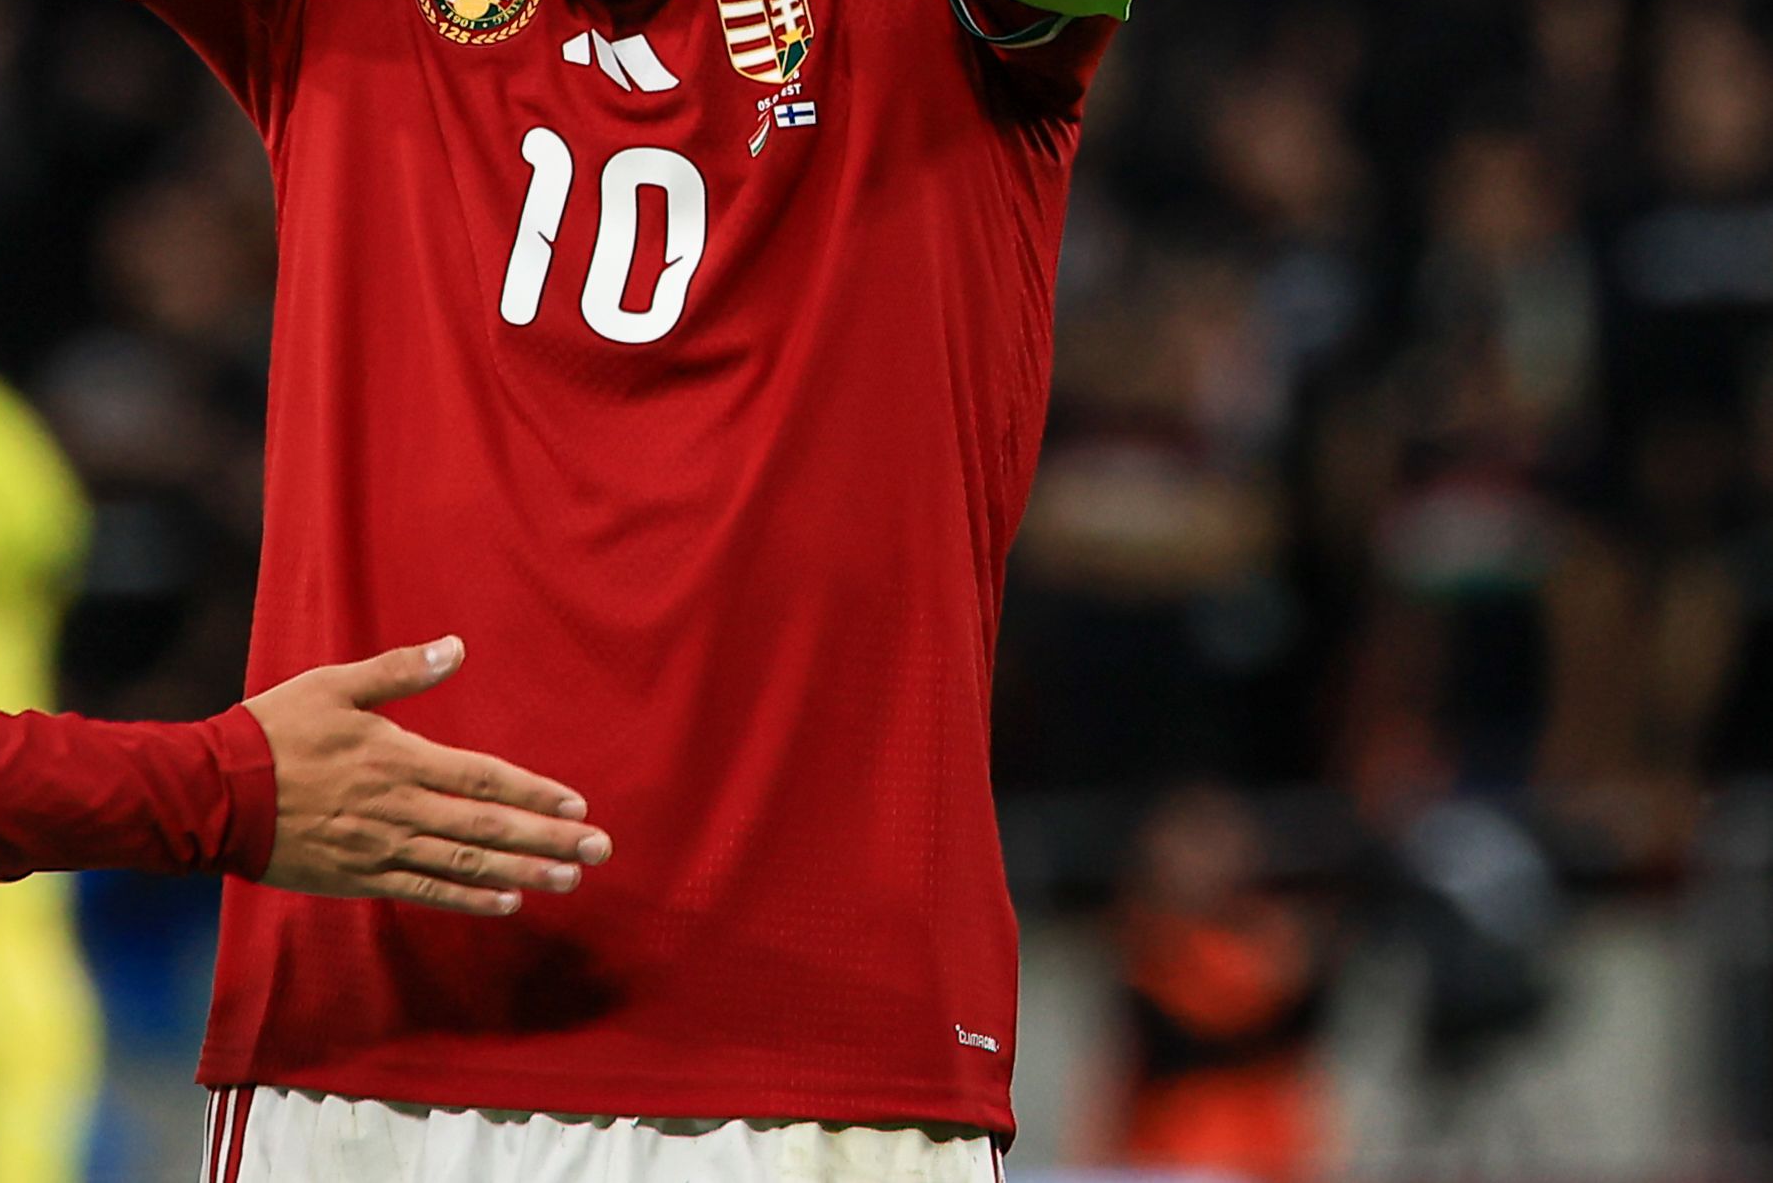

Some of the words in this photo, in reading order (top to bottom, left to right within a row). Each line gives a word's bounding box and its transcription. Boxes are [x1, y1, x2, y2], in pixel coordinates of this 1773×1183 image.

[446, 11, 475, 29] 1901
[439, 22, 471, 44] 125
[500, 126, 706, 344] 10
